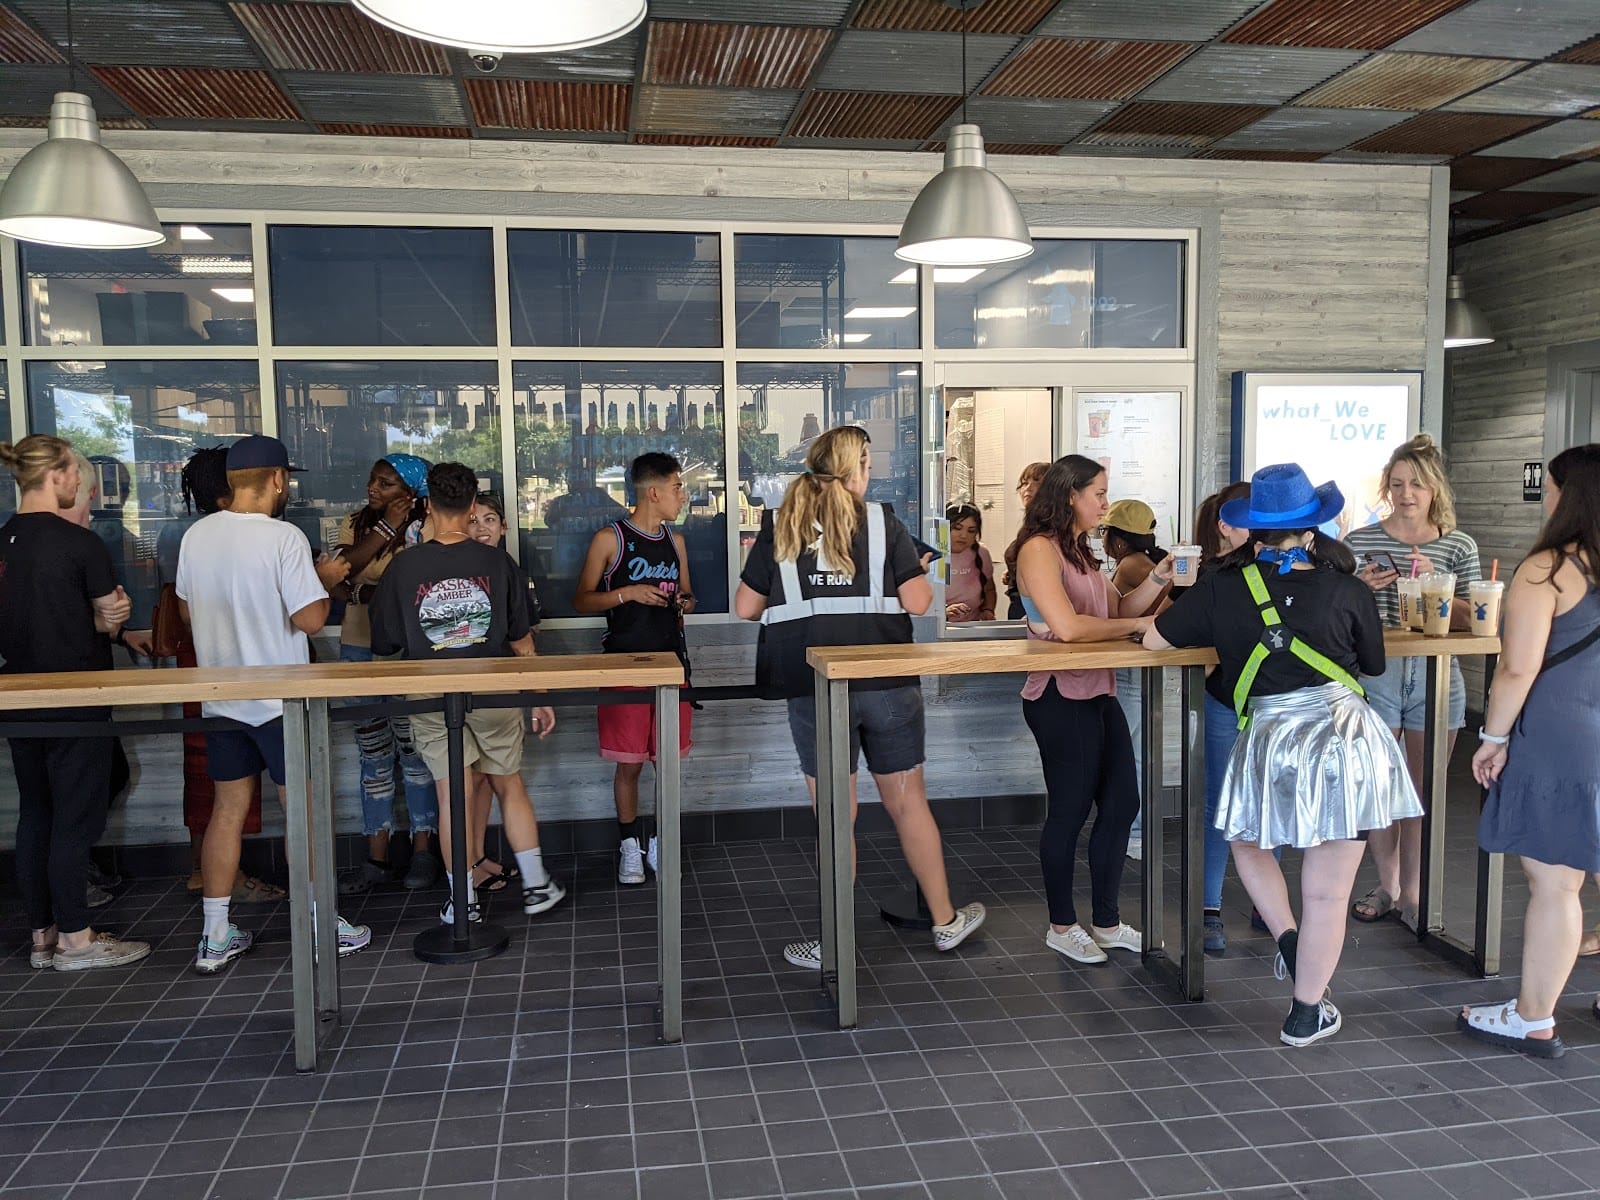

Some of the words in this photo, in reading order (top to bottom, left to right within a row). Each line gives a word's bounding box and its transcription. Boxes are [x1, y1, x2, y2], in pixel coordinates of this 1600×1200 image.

[1330, 423, 1387, 440] LOVE
[628, 556, 679, 581] Dutch
[826, 574, 853, 585] RUN
[414, 576, 491, 606] ALASKAN
[437, 590, 472, 602] AMBER
